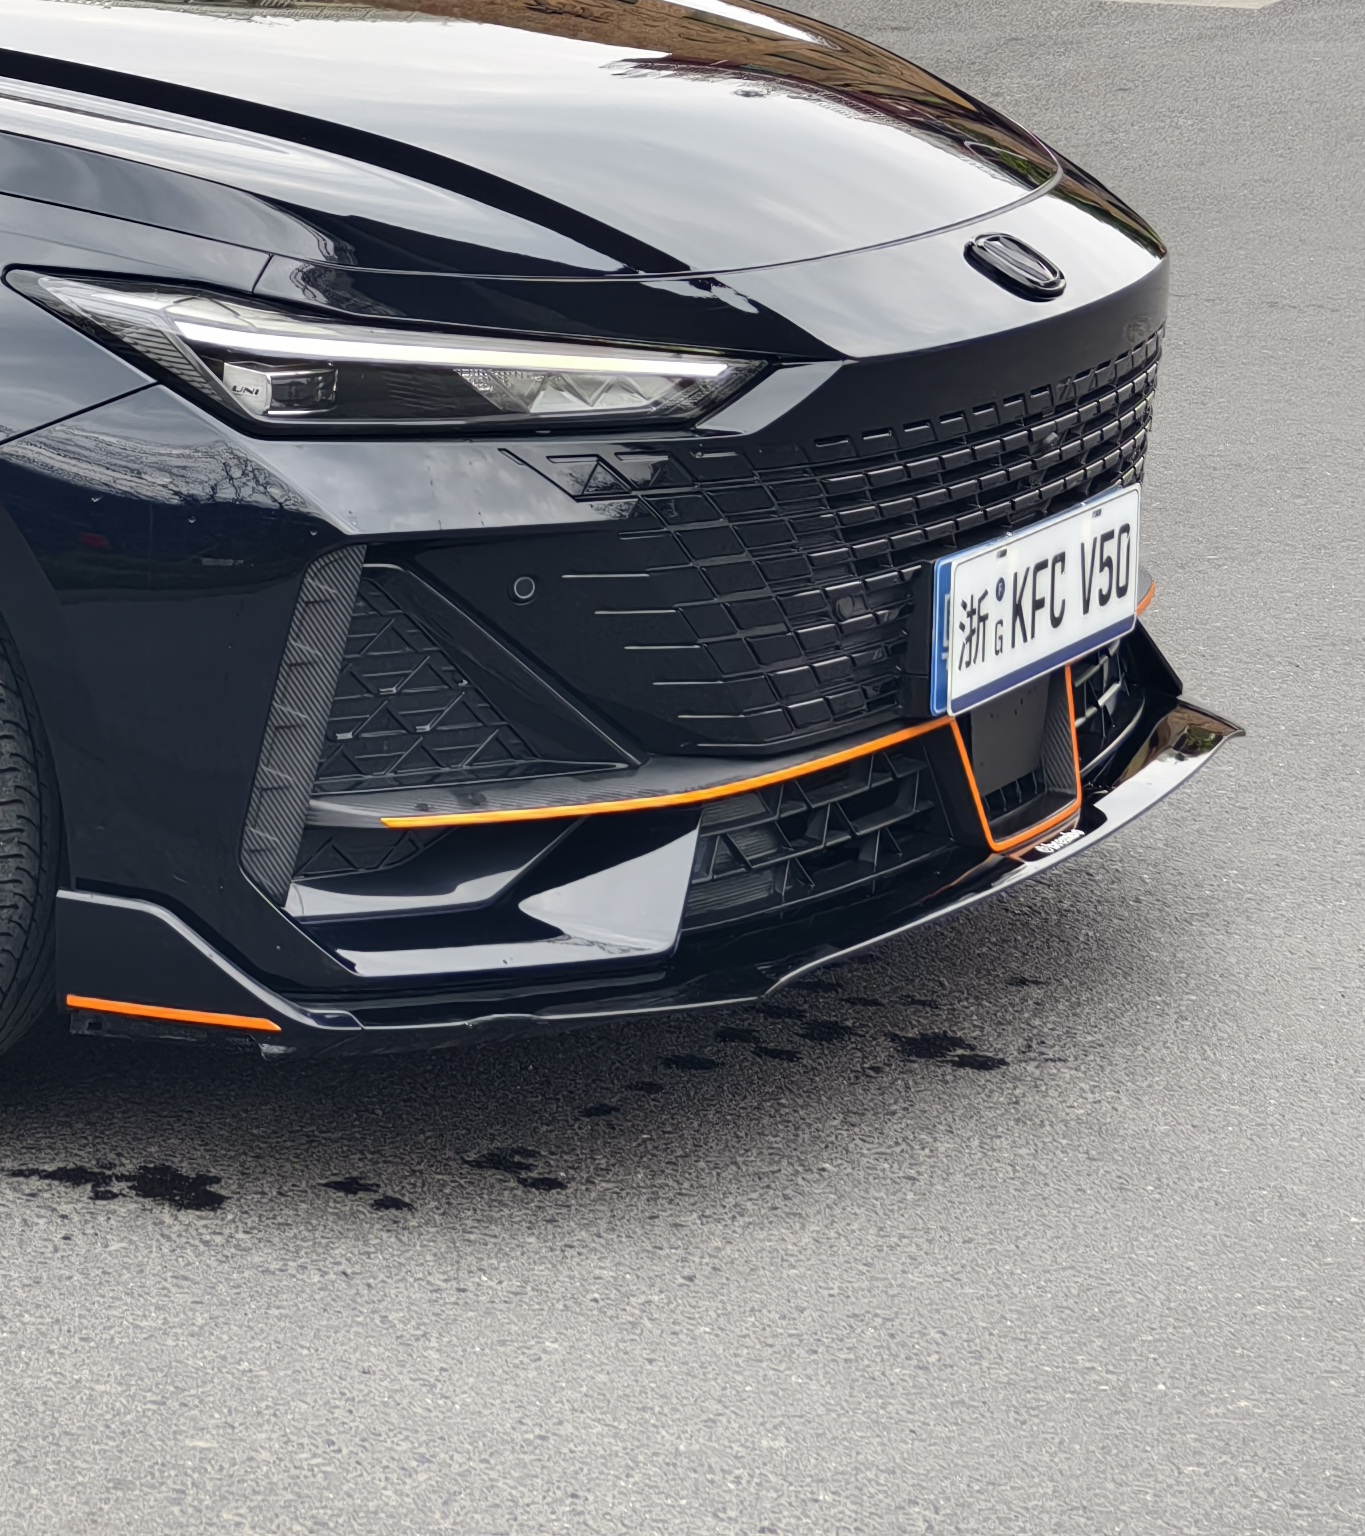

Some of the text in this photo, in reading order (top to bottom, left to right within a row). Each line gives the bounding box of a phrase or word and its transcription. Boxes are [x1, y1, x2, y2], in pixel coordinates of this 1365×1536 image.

[232, 384, 260, 396] UNI
[958, 589, 989, 671] 浙
[1011, 551, 1067, 649] KFC
[1081, 522, 1131, 616] V50
